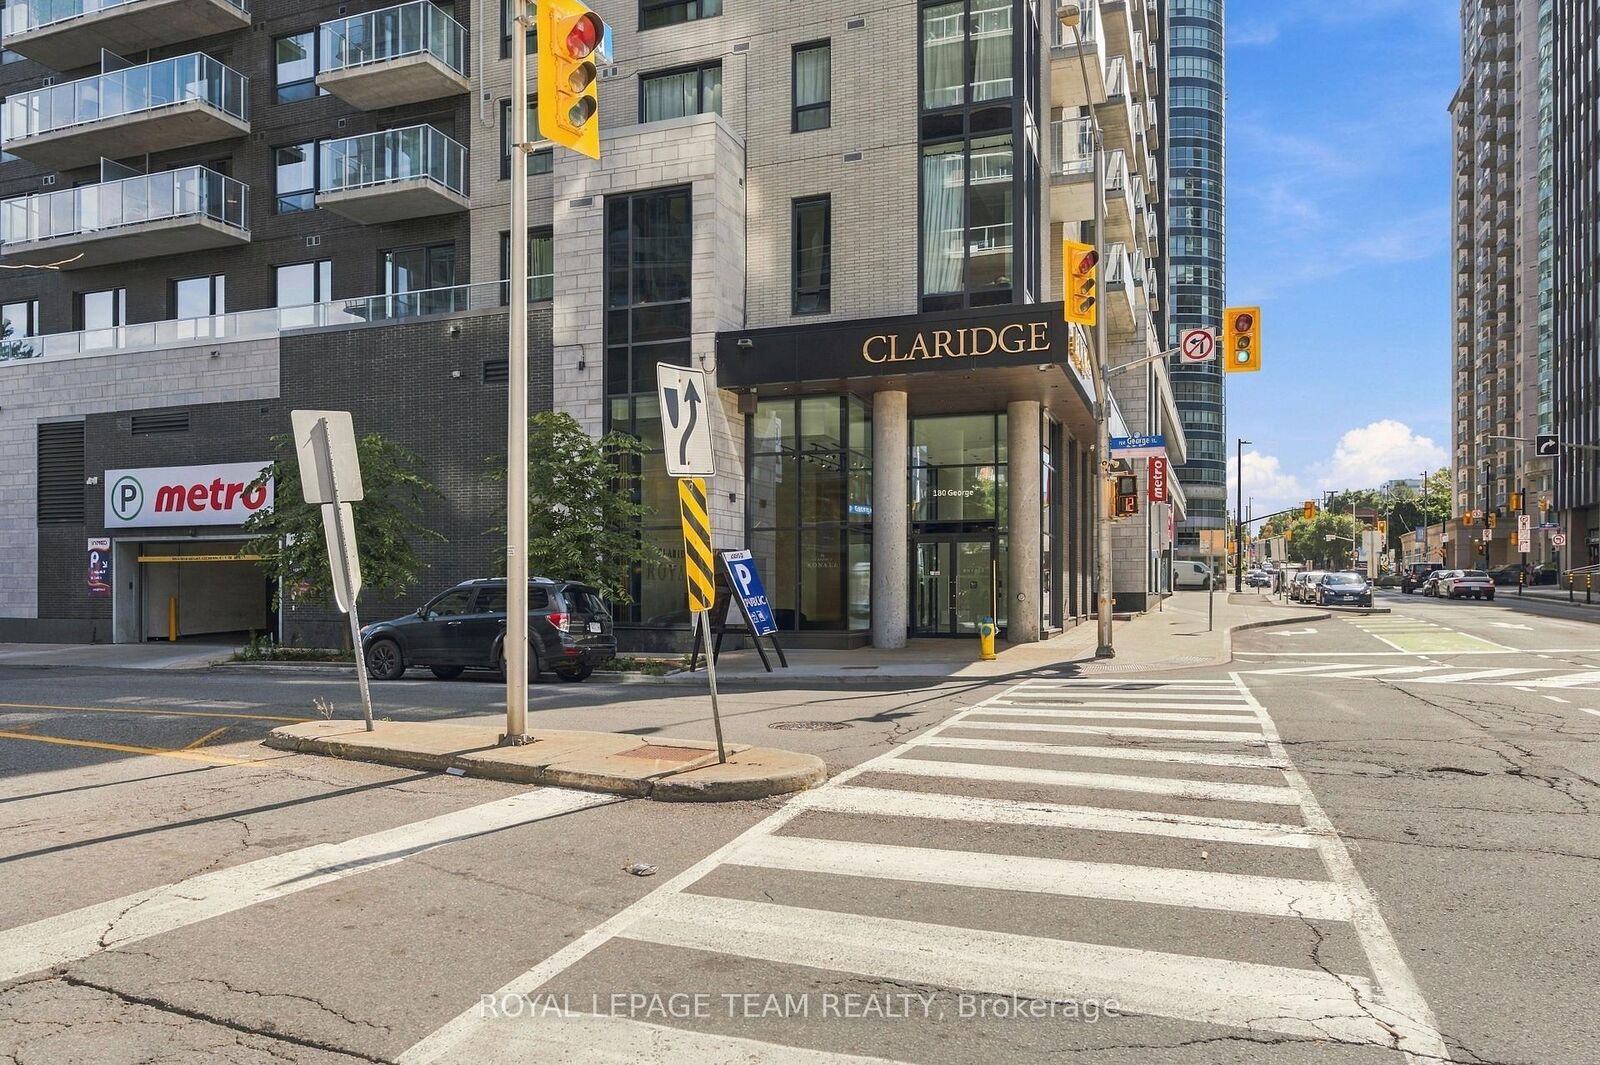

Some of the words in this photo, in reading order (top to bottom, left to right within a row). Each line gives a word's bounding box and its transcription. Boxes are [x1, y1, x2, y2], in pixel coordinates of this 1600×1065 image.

[862, 321, 1051, 364] CLARIDGE
[1126, 437, 1150, 446] George
[1153, 460, 1163, 498] metro
[120, 484, 137, 512] P
[154, 477, 267, 513] metro
[932, 489, 946, 497] 180
[947, 489, 974, 498] George
[90, 551, 100, 568] P
[733, 563, 752, 595] P
[743, 595, 767, 608] PUBLIC
